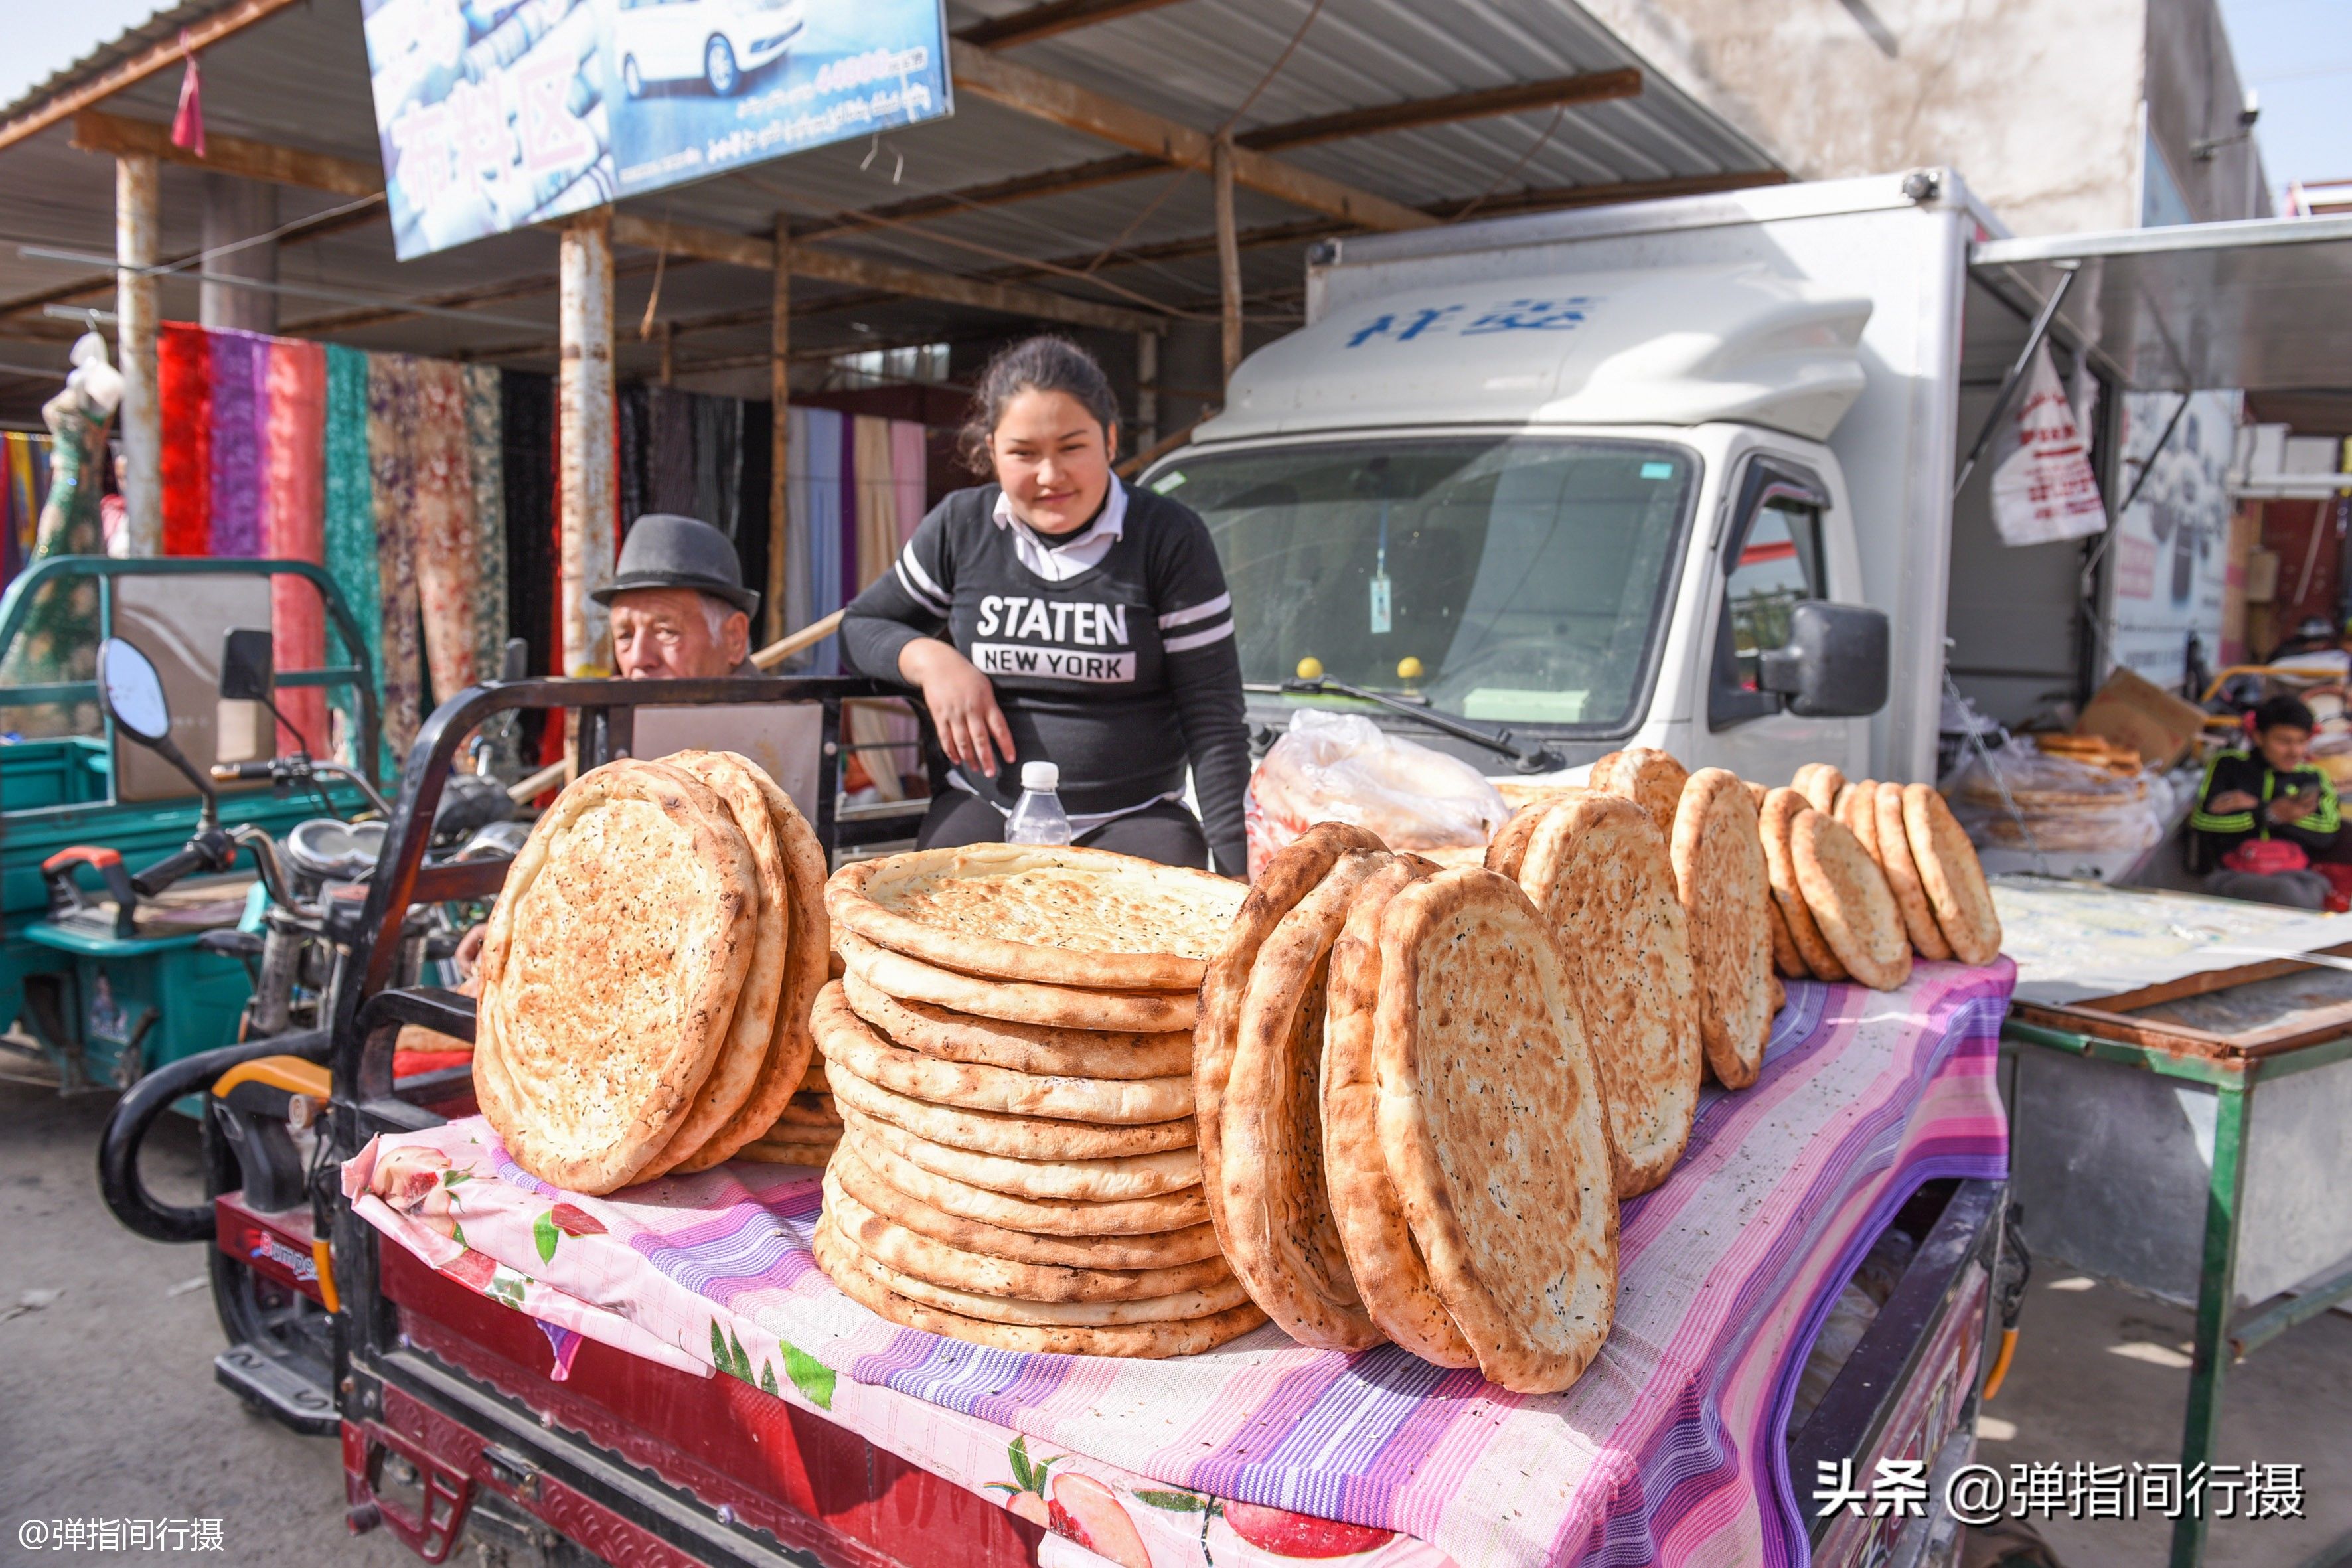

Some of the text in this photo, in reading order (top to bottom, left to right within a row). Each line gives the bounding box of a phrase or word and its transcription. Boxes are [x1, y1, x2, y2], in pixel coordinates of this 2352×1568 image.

[397, 53, 589, 207] 布料区
[976, 595, 1130, 646] STATEN
[985, 650, 1122, 679] NEW YORK
[260, 1230, 318, 1277] Bumpe
